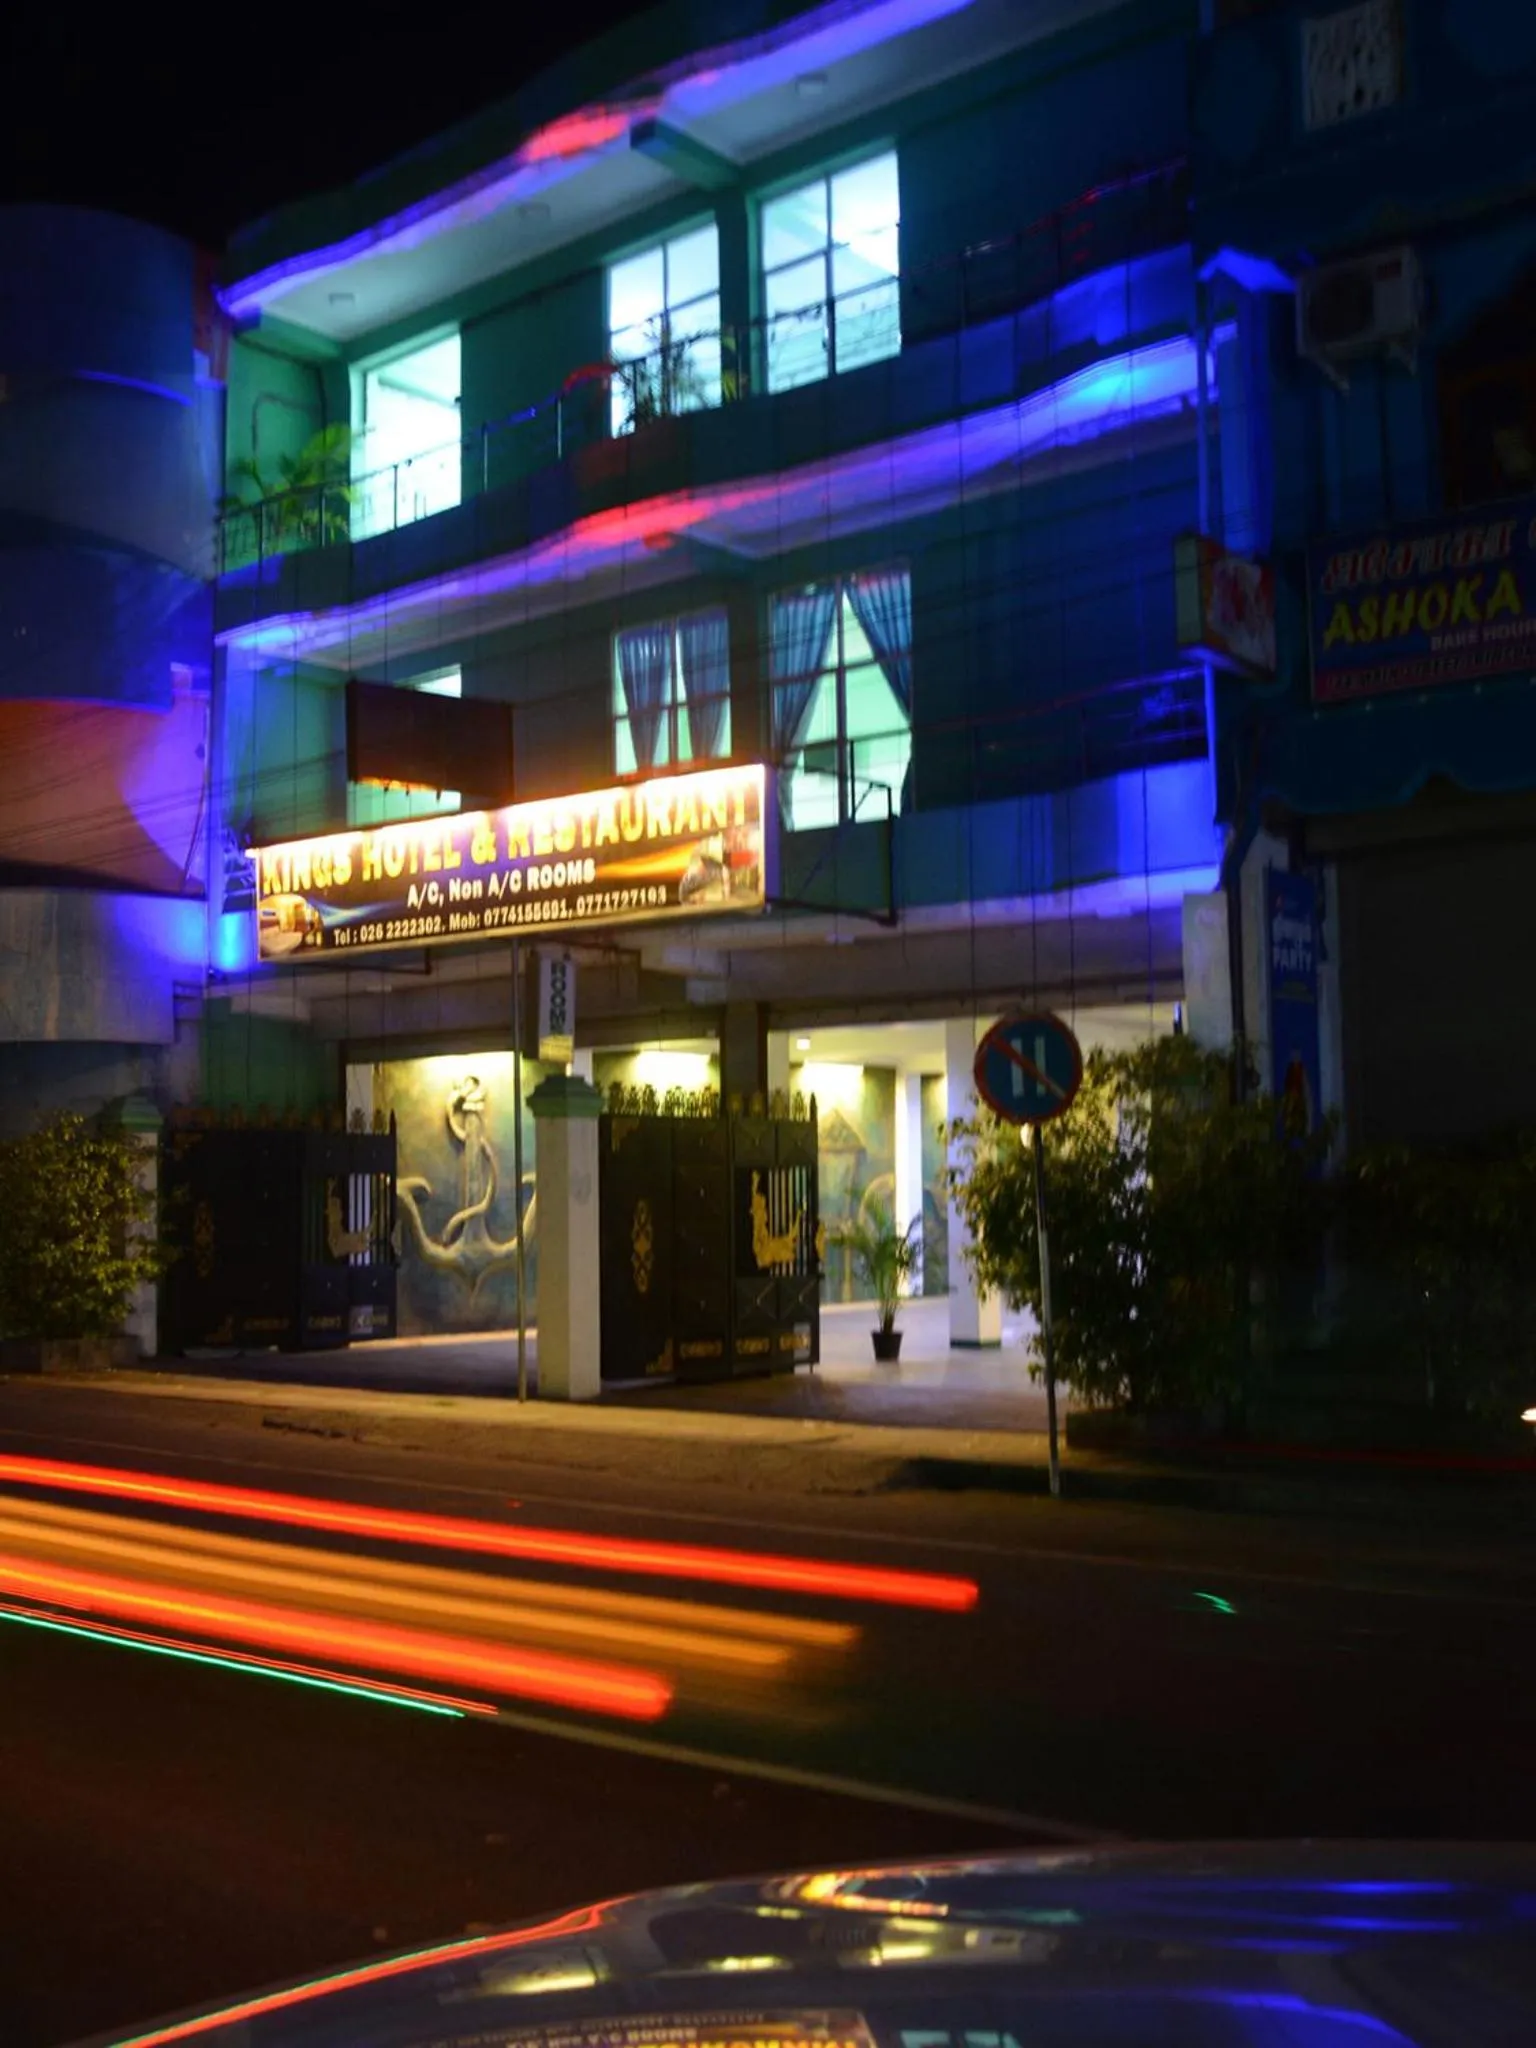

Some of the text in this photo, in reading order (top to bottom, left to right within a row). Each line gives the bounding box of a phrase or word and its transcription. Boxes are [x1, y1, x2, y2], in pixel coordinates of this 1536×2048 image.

[1323, 569, 1521, 650] ASHOKA
[262, 783, 746, 895] KINGS HOTEL & RESTAURANT
[449, 877, 483, 902] Non
[488, 868, 523, 901] A/C
[526, 857, 596, 892] ROOMS
[360, 923, 384, 943] 026
[1273, 947, 1312, 973] PARTY
